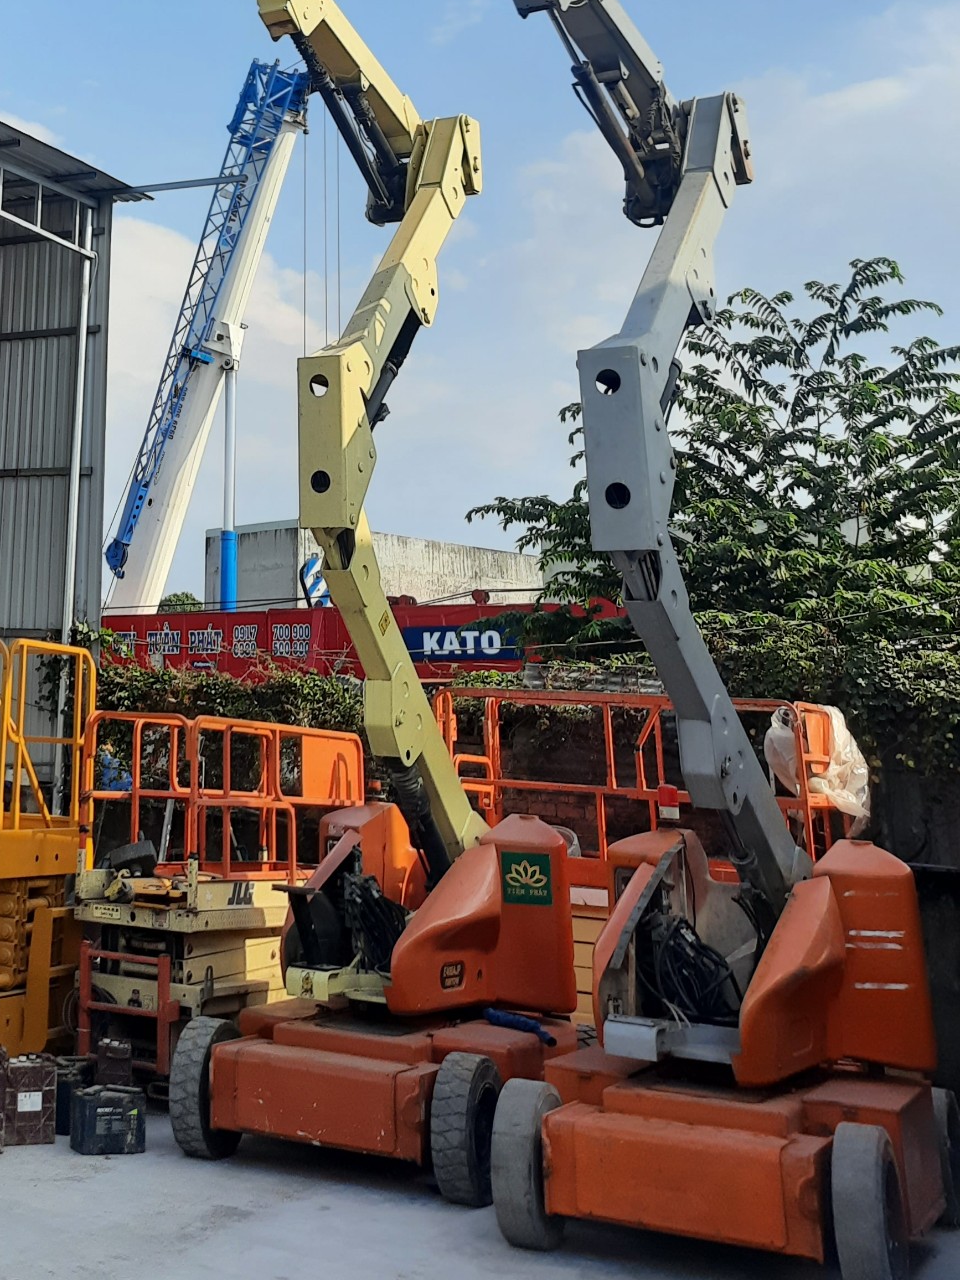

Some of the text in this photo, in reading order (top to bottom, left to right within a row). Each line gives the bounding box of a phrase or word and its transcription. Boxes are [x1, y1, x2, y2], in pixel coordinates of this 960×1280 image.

[188, 623, 223, 654] PHÁT
[233, 624, 310, 640] 0917 700 900
[422, 630, 501, 655] KATO
[227, 881, 254, 906] JLG
